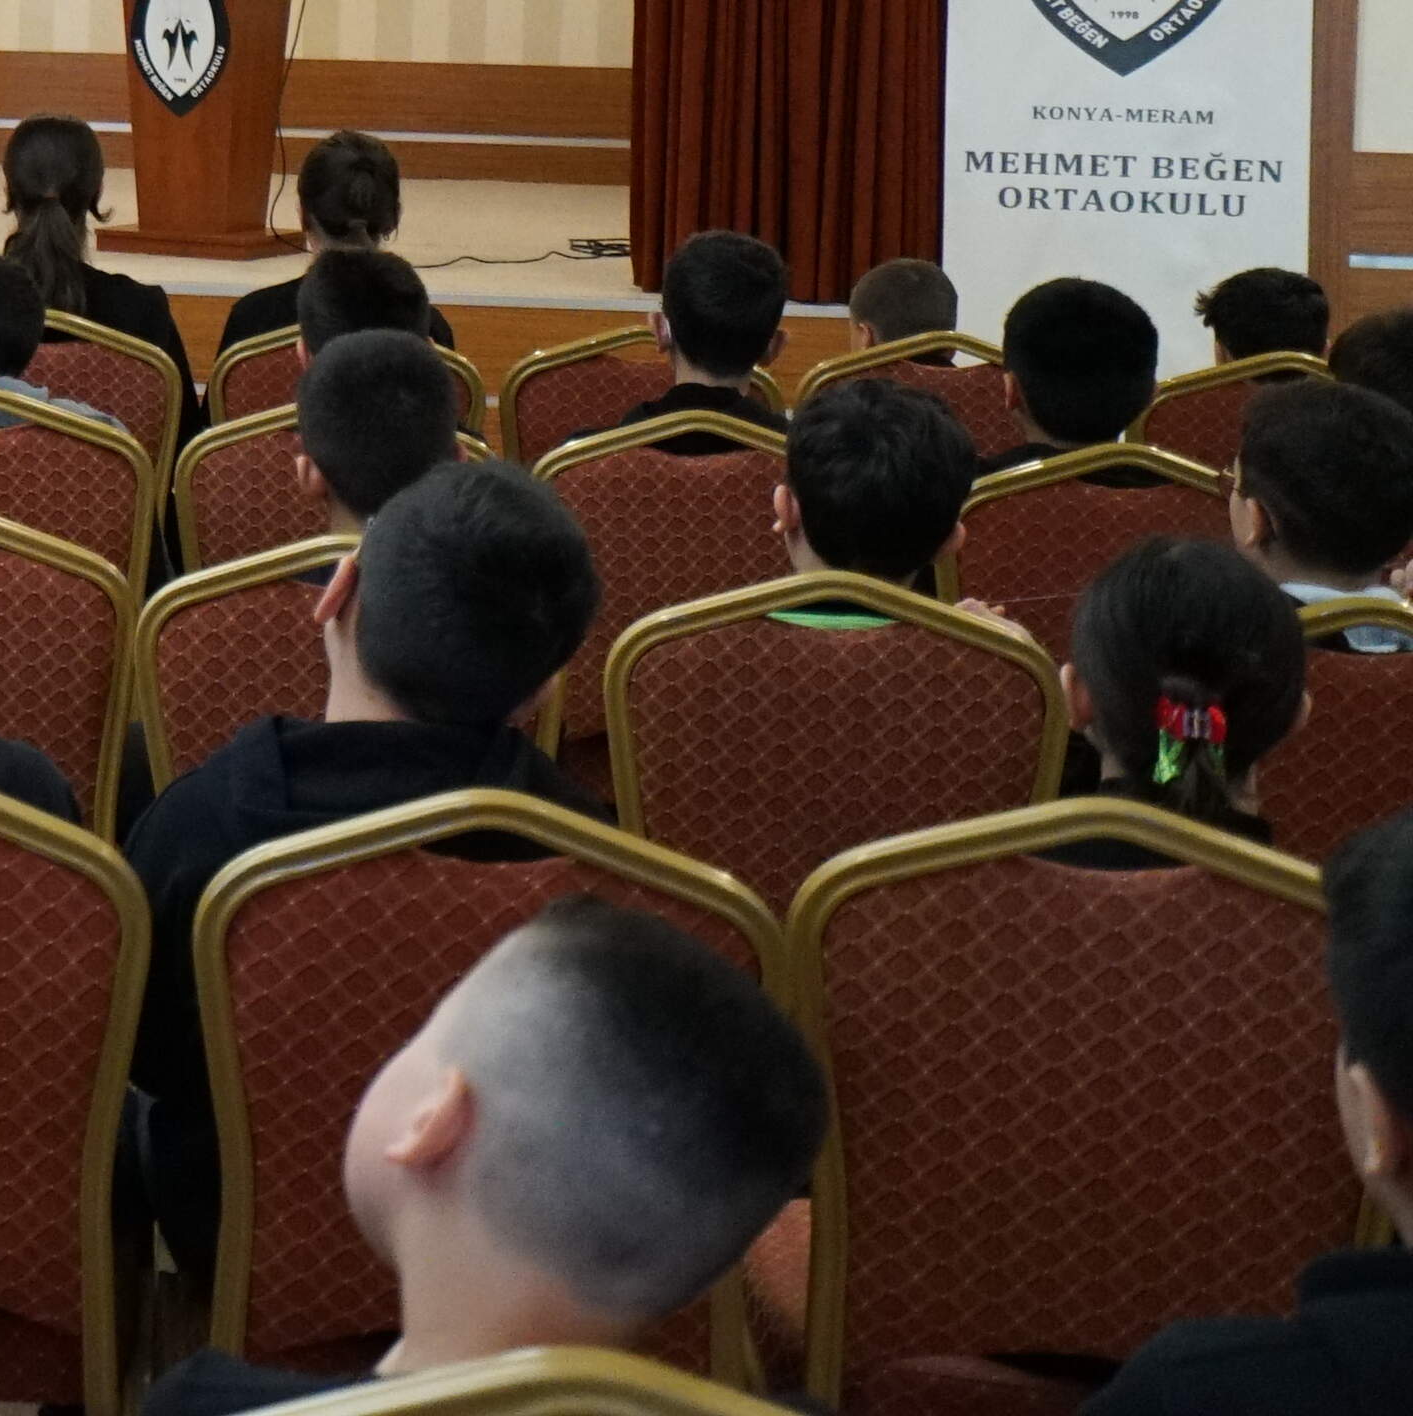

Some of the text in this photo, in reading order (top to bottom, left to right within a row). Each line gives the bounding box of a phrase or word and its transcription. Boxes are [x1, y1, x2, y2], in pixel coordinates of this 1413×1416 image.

[1057, 3, 1109, 49] BEĞEN
[1111, 10, 1140, 20] 1998
[190, 45, 226, 98] ORTAOKULU
[1031, 105, 1215, 125] KONYA-MERAM
[964, 150, 1284, 184] MEHMET BEĞEN
[997, 186, 1247, 218] ORTAOKULU
